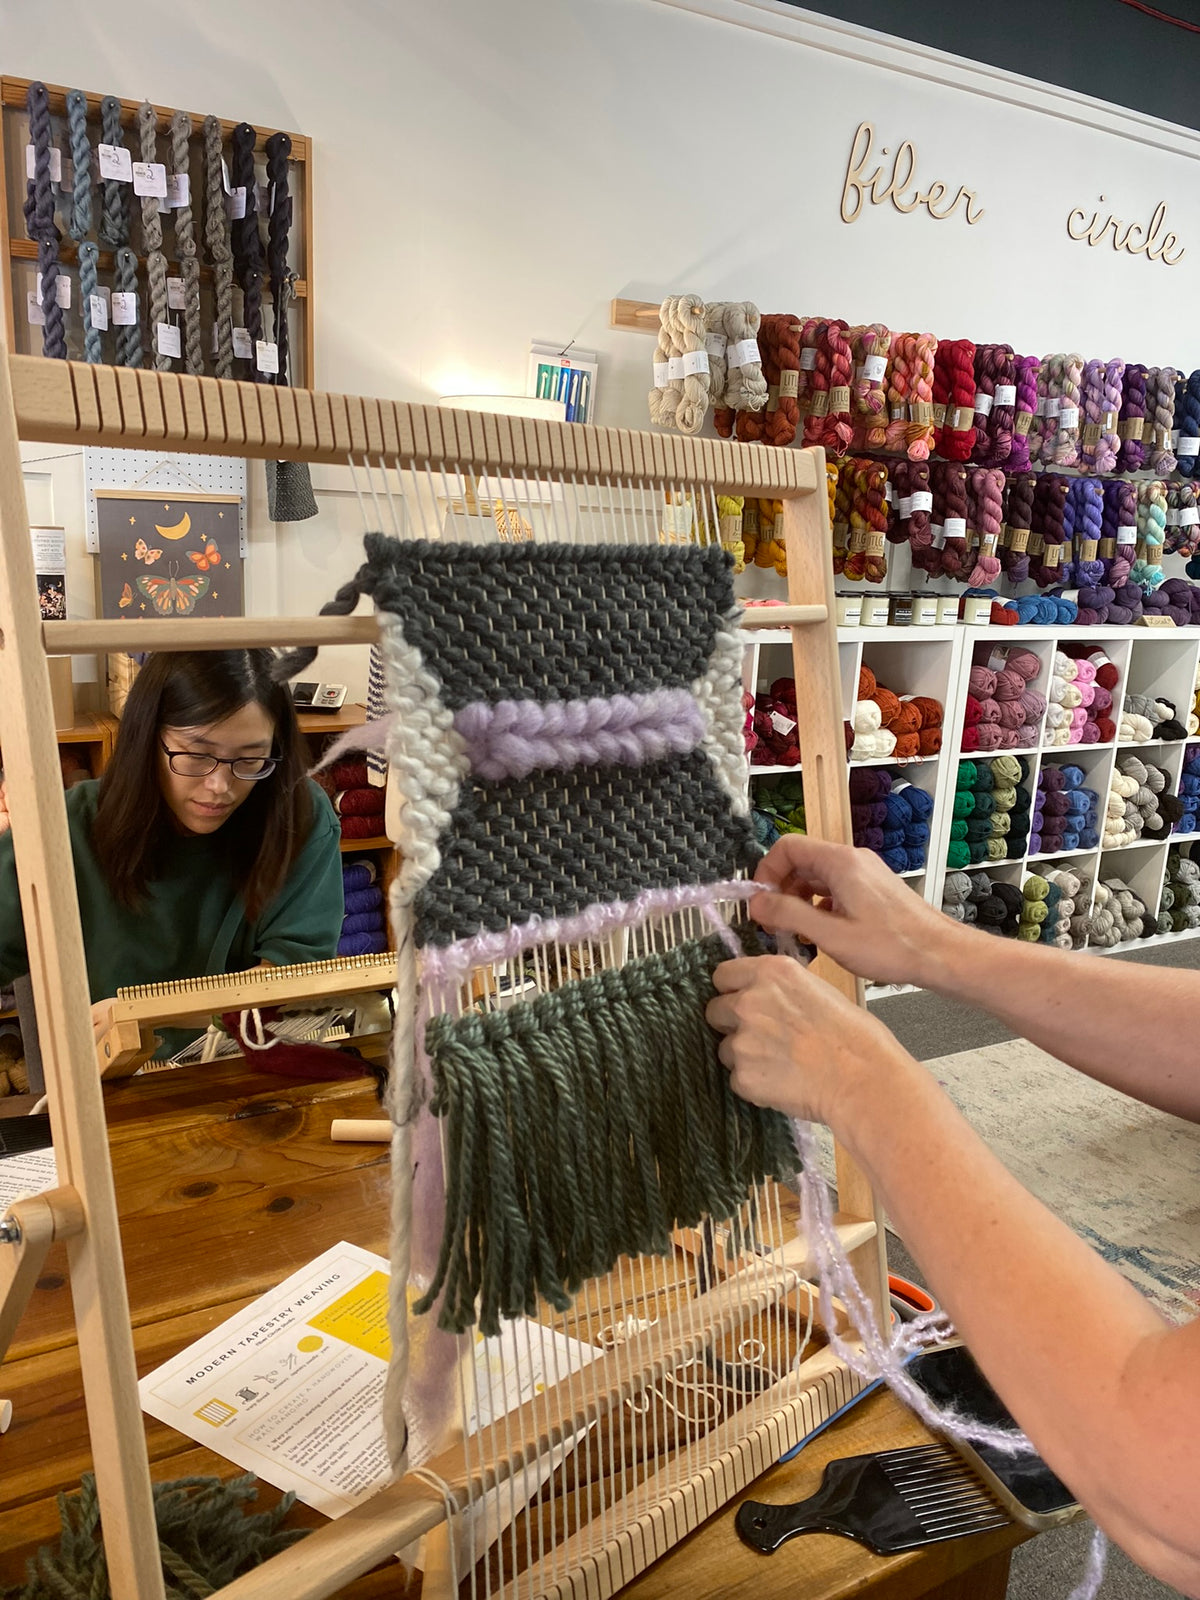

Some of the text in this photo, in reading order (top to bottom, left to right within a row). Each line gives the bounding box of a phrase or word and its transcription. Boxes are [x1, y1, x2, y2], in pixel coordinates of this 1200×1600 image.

[840, 121, 1185, 266] fiber circle
[186, 1348, 237, 1385] MODERN
[238, 1307, 293, 1347] TAPESTRY
[294, 1274, 341, 1307] WEAVING
